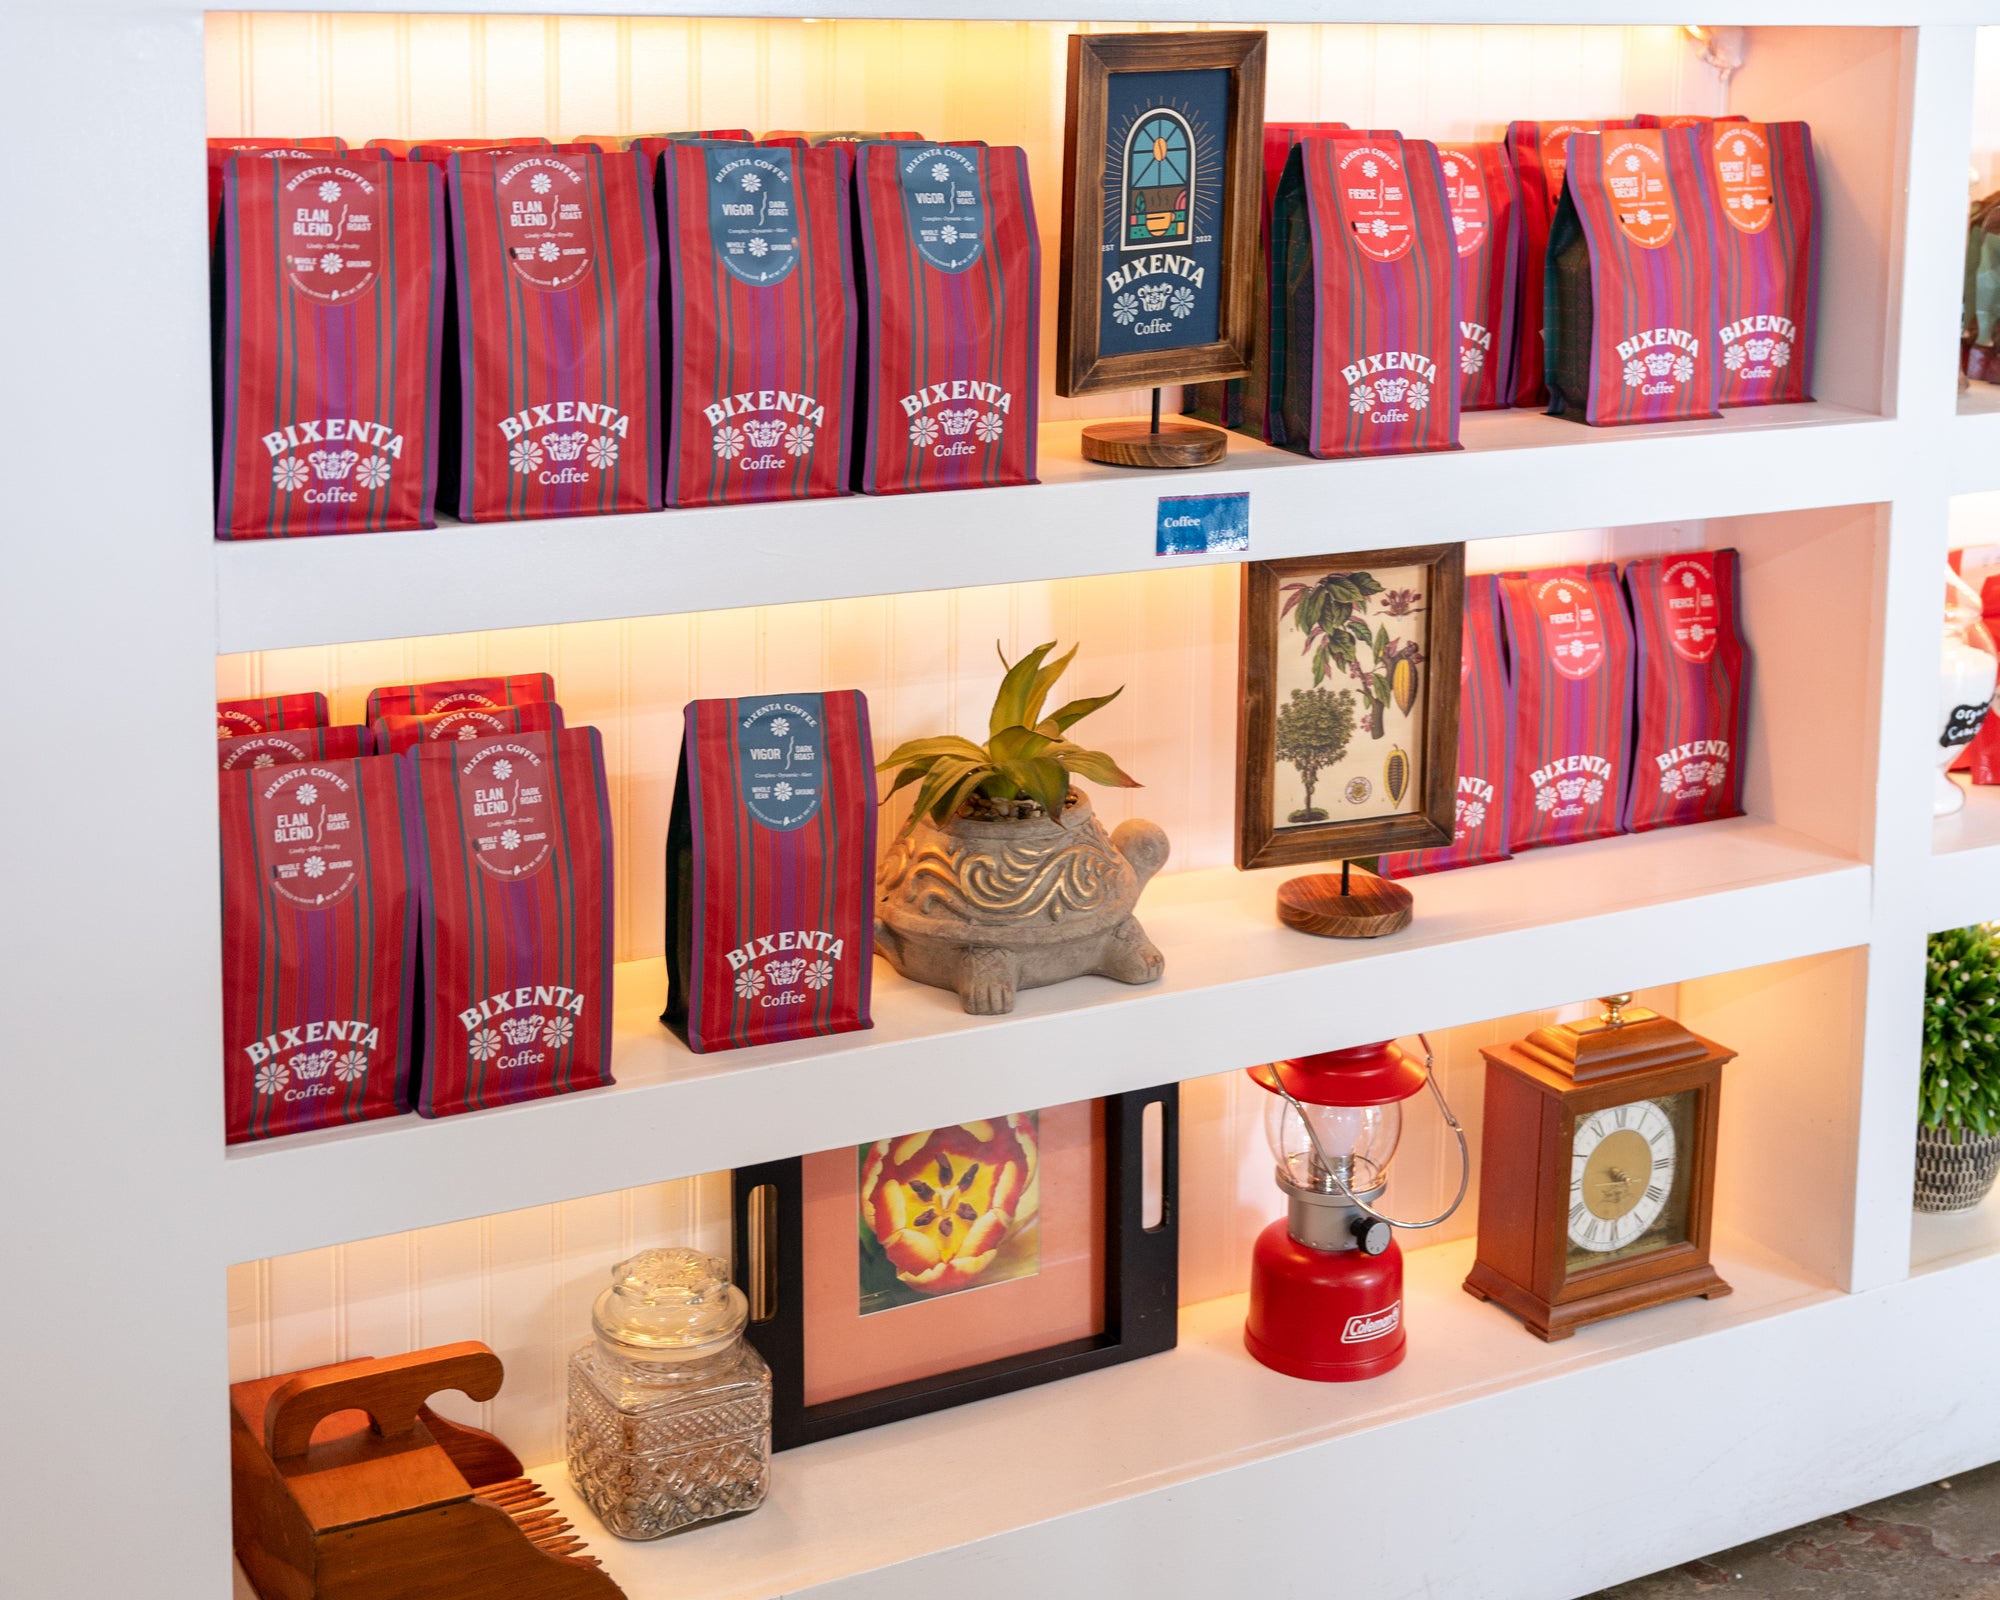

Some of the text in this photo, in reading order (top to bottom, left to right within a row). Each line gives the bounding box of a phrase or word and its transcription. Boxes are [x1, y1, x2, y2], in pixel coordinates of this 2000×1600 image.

[905, 148, 976, 174] BIXENTA COFFEE
[1340, 148, 1399, 170] BIXENTA COFFEE
[500, 158, 582, 185] BIXENTA COFFEE
[715, 158, 790, 184] BIXENTA COFFEE
[286, 167, 375, 195] BIXENTA COFFEE
[1610, 177, 1638, 187] ESPRIT
[915, 193, 945, 204] VIGOR
[1348, 189, 1377, 199] FIERCE
[1613, 187, 1638, 198] DECAF
[297, 208, 329, 222] ELAN
[512, 201, 542, 214] ELAN
[722, 204, 754, 216] VIGOR
[293, 222, 333, 236] BLEND
[510, 214, 547, 226] BLEND
[1106, 254, 1205, 294] BIXENTA
[1134, 318, 1172, 335] Coffee
[1719, 315, 1796, 345] BIXENTA
[1616, 328, 1699, 360] BIXENTA
[1341, 352, 1437, 385] BIXENTA
[1740, 365, 1772, 379] Coffee
[1642, 382, 1675, 395] Coffee
[899, 380, 1011, 417] BIXENTA
[703, 390, 825, 428] BIXENTA
[1371, 408, 1408, 424] Coffee
[498, 401, 630, 442] BIXENTA
[262, 419, 404, 459] BIXENTA
[933, 442, 976, 457] Coffee
[740, 454, 786, 470] Coffee
[538, 467, 589, 485] Coffee
[304, 486, 358, 504] Coffee
[1164, 516, 1200, 528] Coffee
[1669, 598, 1694, 608] FIERCE
[1550, 612, 1575, 624] FIERCE
[429, 694, 465, 714] IXENTA
[225, 711, 262, 732] COFFEE
[742, 704, 818, 728] BIXENTA COFFEE
[430, 712, 505, 739] BIXENTA COFFEE
[223, 738, 305, 770] BIXENTA COFFEE
[463, 744, 541, 775] BIXENTA COFFEE
[750, 748, 781, 760] VIGOR
[794, 752, 815, 760] ROAST
[1655, 740, 1730, 771] BIXENTA
[1530, 755, 1612, 788] BIXENTA
[264, 768, 349, 799] BIXENTA COFFEE
[475, 788, 504, 802] ELAN
[474, 800, 508, 816] BLEND
[1552, 804, 1584, 818] Coffee
[277, 813, 308, 828] ELAN
[274, 826, 314, 842] BLEND
[725, 931, 844, 971] BIXENTA
[760, 990, 806, 1008] Coffee
[458, 985, 585, 1032] BIXENTA
[244, 1020, 379, 1066] BIXENTA
[497, 1051, 545, 1070] Coffee
[284, 1084, 336, 1102] Coffee
